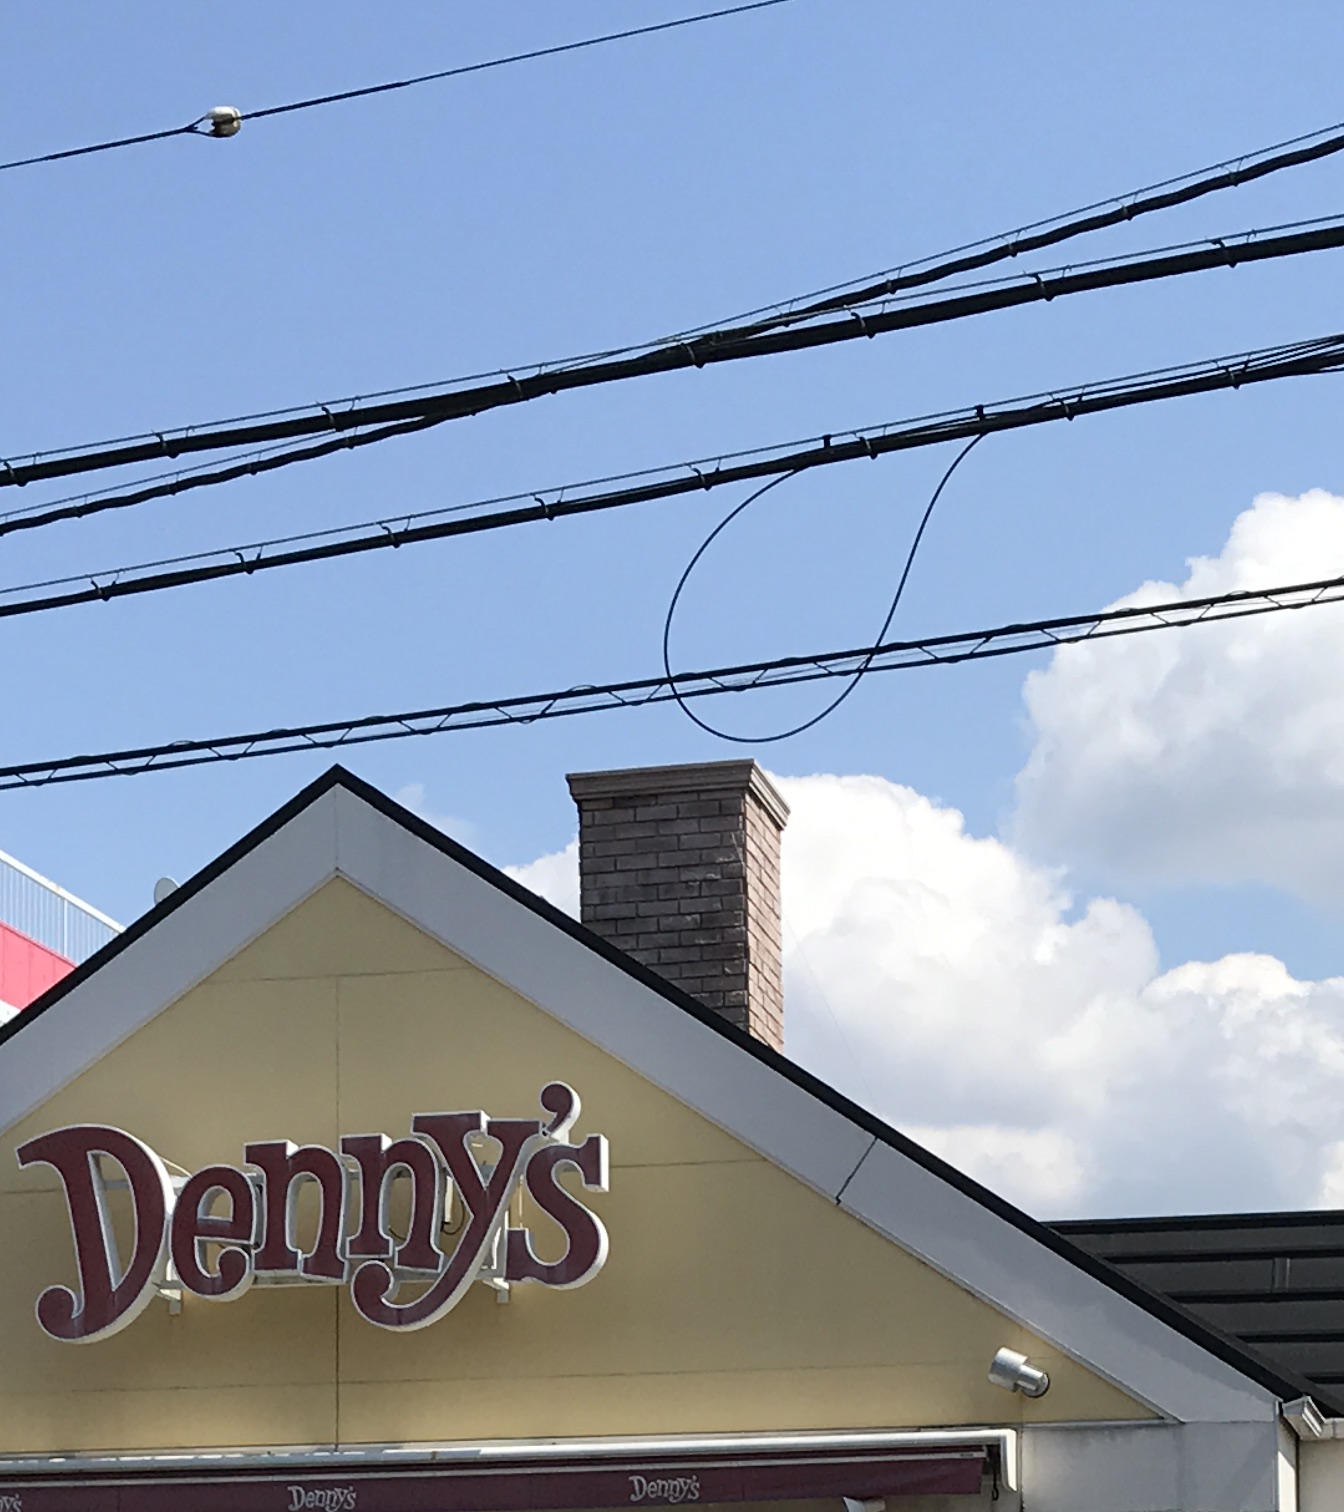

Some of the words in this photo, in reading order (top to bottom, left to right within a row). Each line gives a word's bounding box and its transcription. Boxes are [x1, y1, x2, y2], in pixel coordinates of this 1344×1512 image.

[16, 1081, 609, 1343] Denny's
[287, 1485, 356, 1512] Denny's
[629, 1474, 700, 1502] Denny's
